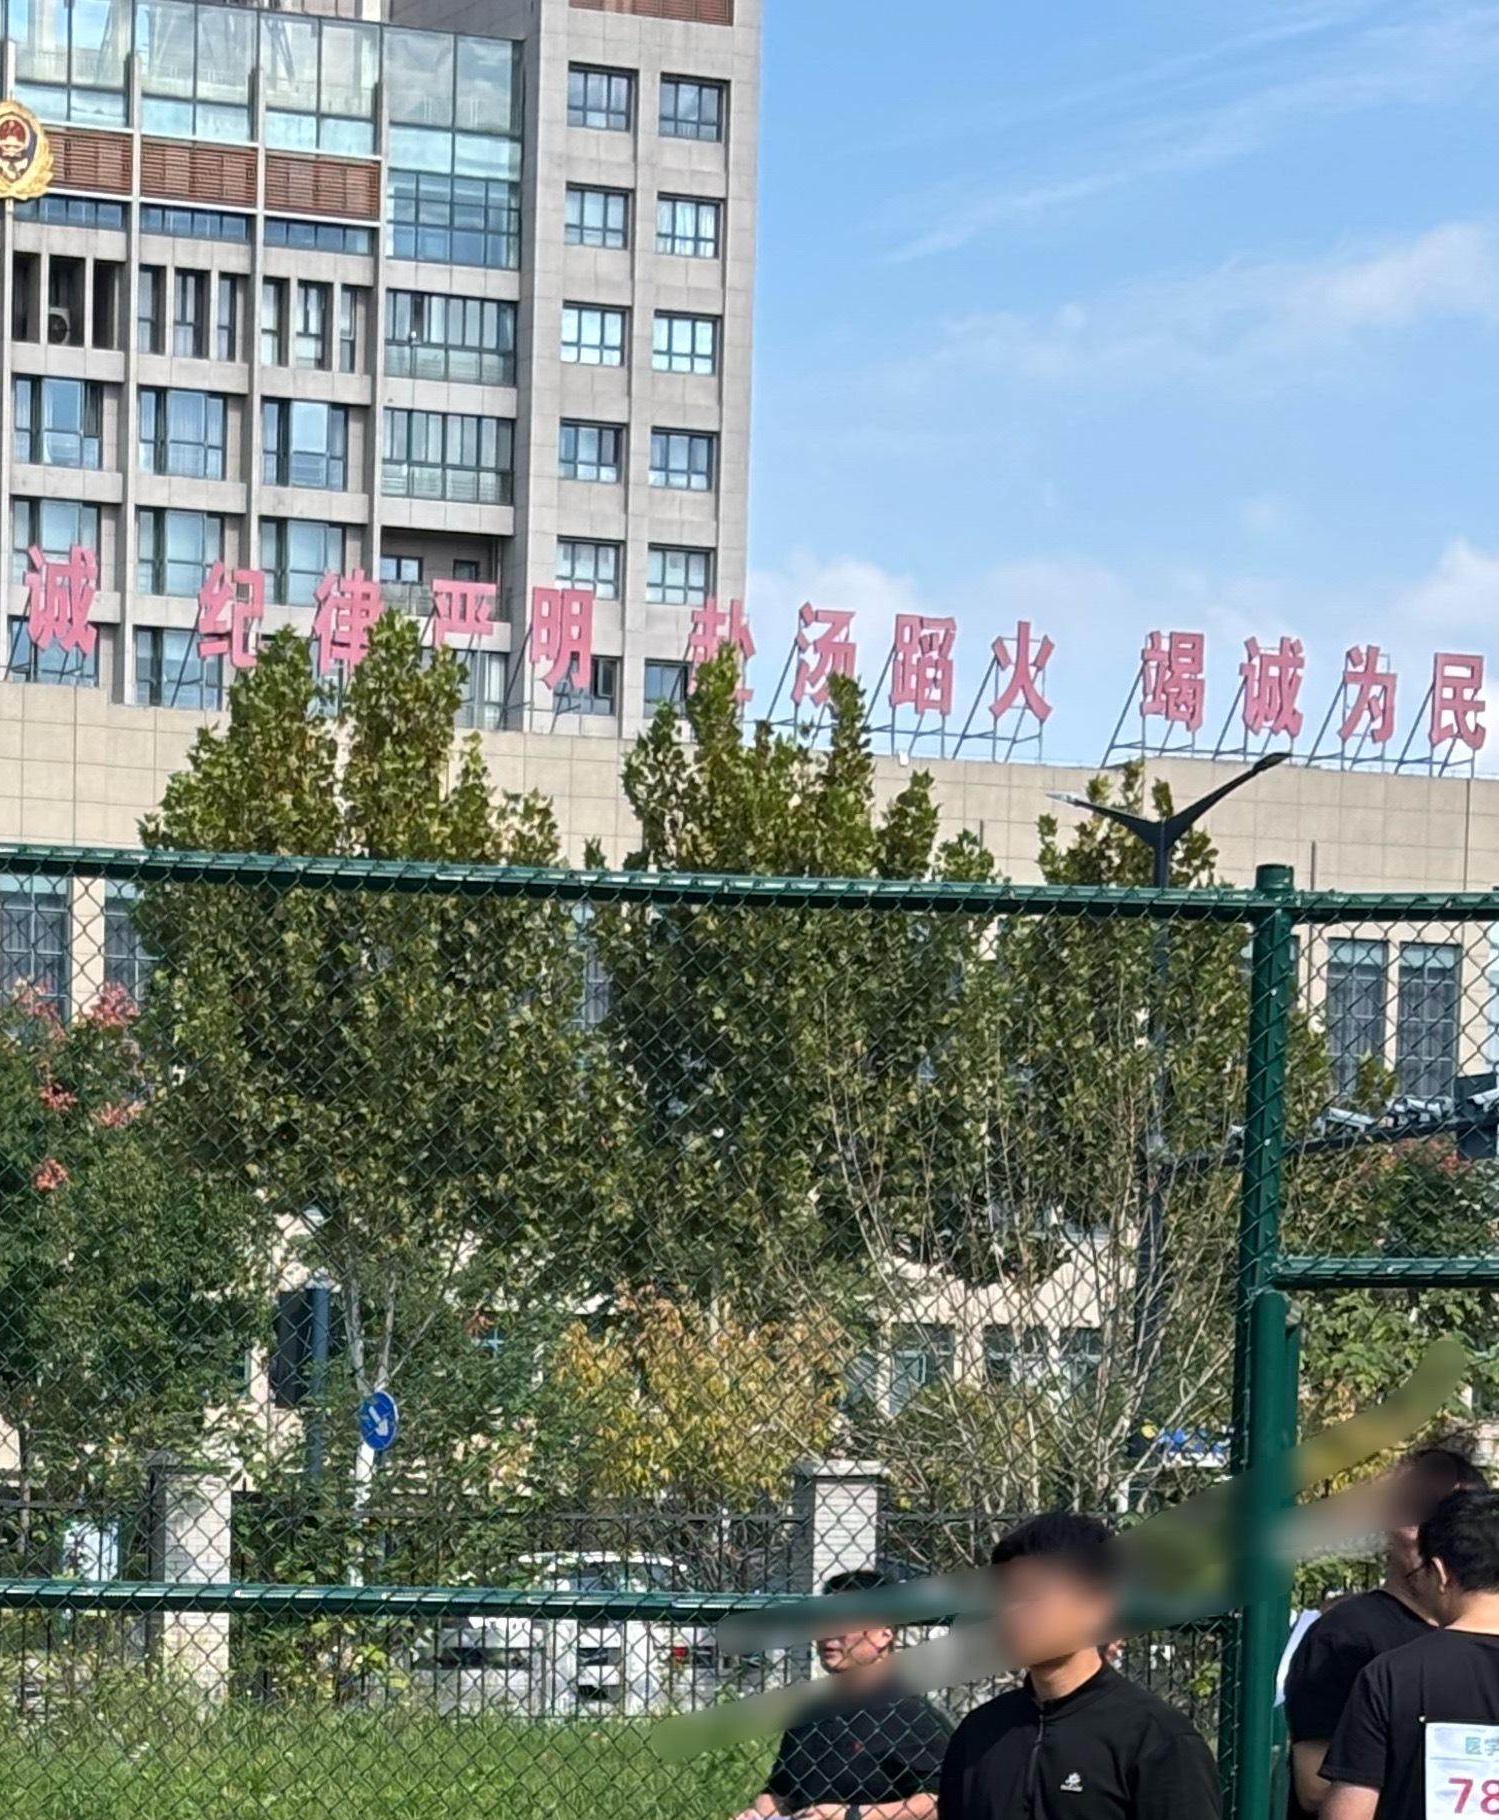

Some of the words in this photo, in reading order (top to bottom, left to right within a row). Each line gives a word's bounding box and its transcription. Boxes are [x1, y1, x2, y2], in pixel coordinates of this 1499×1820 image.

[197, 560, 595, 689] 纪律严明
[1139, 631, 1487, 750] 竭诚为民
[1448, 1777, 1499, 1815] 78
